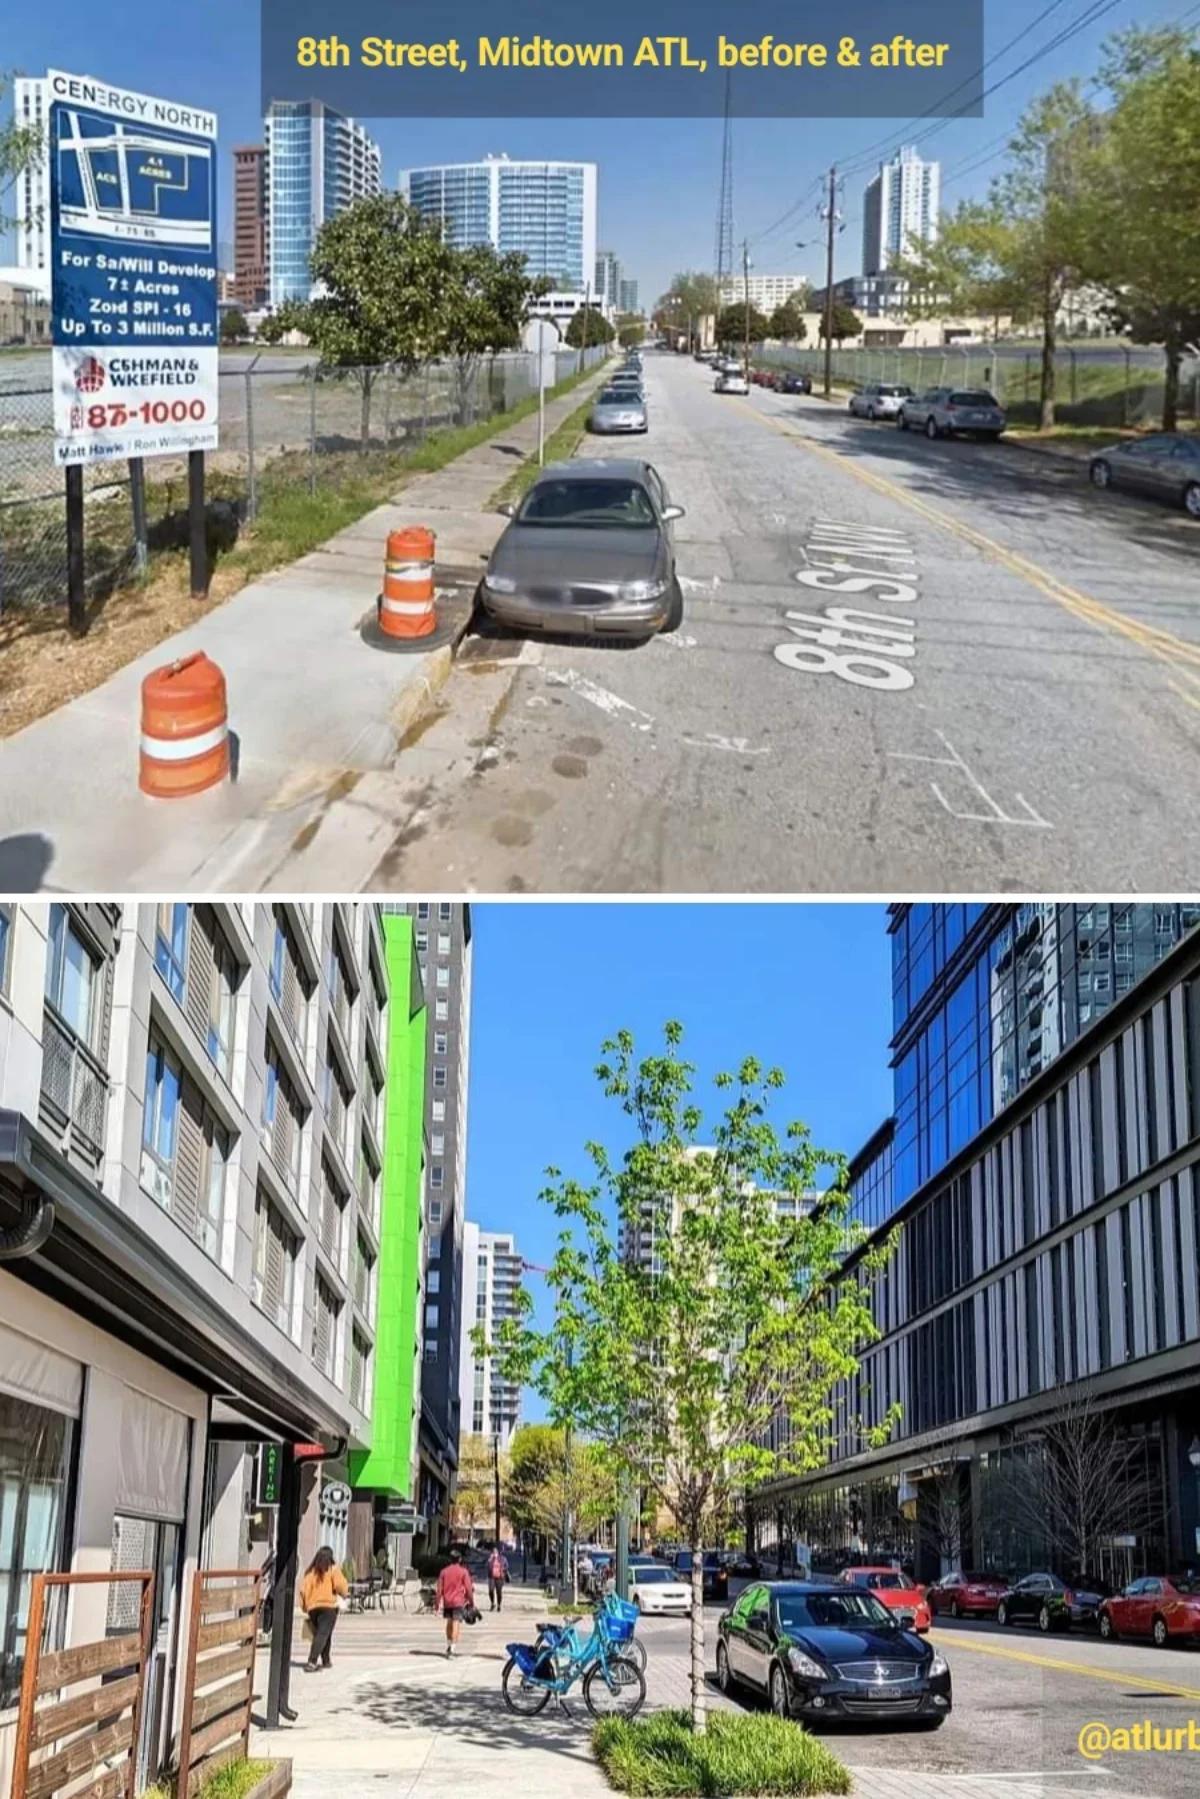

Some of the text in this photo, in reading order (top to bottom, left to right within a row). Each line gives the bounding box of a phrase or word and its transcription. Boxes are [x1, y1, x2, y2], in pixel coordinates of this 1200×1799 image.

[154, 105, 213, 133] NORTH
[61, 251, 91, 267] For
[158, 260, 216, 281] Develop
[134, 279, 180, 296] Acres
[133, 301, 160, 316] SPI
[174, 303, 192, 317] 16
[61, 318, 214, 337] Up To 3 Million S.F.
[773, 606, 917, 691] 8th
[265, 1442, 277, 1501] ARKING
